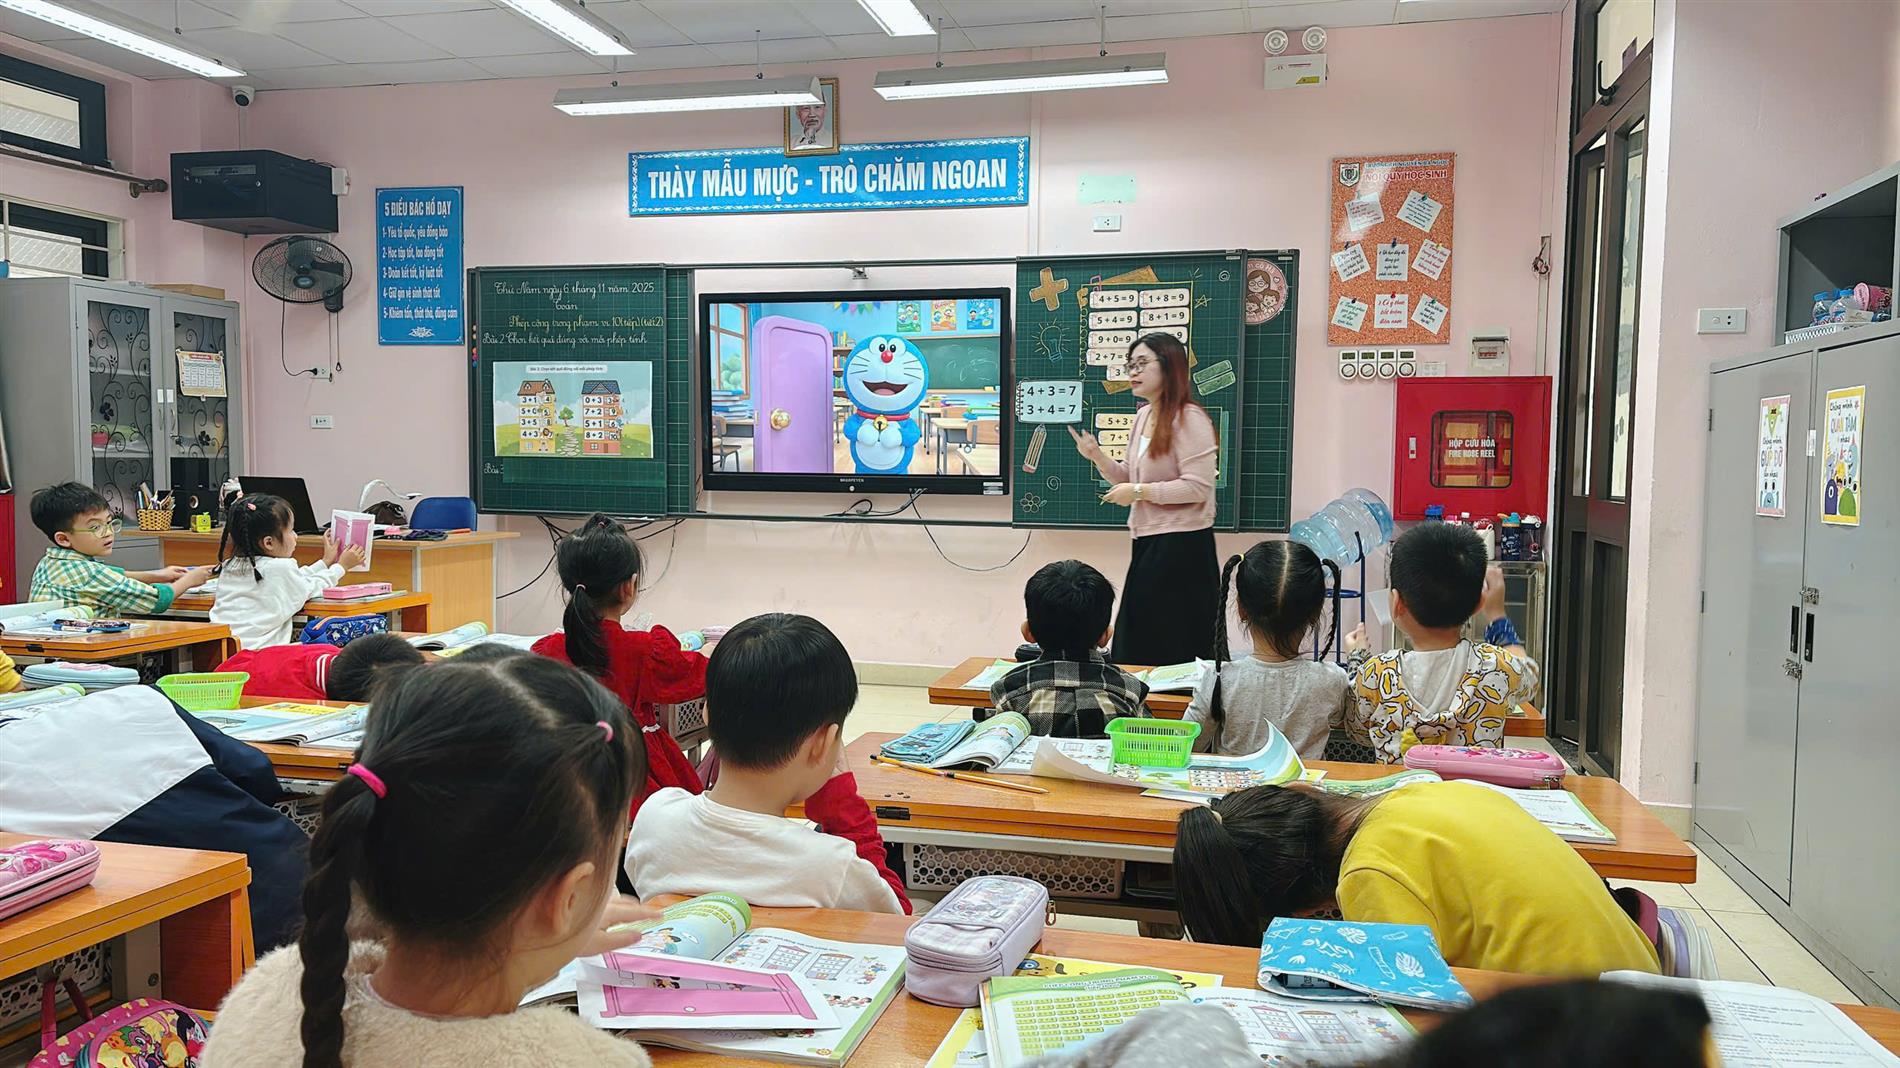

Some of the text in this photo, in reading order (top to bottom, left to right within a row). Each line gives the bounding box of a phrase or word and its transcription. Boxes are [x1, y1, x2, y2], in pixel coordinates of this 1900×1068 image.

[702, 158, 747, 198] MẪU
[753, 164, 799, 202] MỰC
[819, 158, 857, 194] TRÒ
[864, 155, 925, 192] CHĂM
[932, 158, 1007, 190] NGOAN
[1426, 170, 1447, 178] SINH
[385, 196, 451, 218] 5 ĐIỀU BÁC HỒ DẠY
[543, 285, 562, 300] ngày
[563, 283, 569, 293] 6
[572, 281, 596, 299] tháng
[598, 283, 605, 293] 11
[632, 282, 654, 293] 2025
[552, 320, 571, 332] trong
[499, 334, 504, 344] 2
[629, 332, 648, 343] tính
[1449, 438, 1463, 449] HỘP
[1481, 436, 1495, 448] HỎA
[1448, 450, 1462, 458] FIRE
[1481, 450, 1495, 458] REEL
